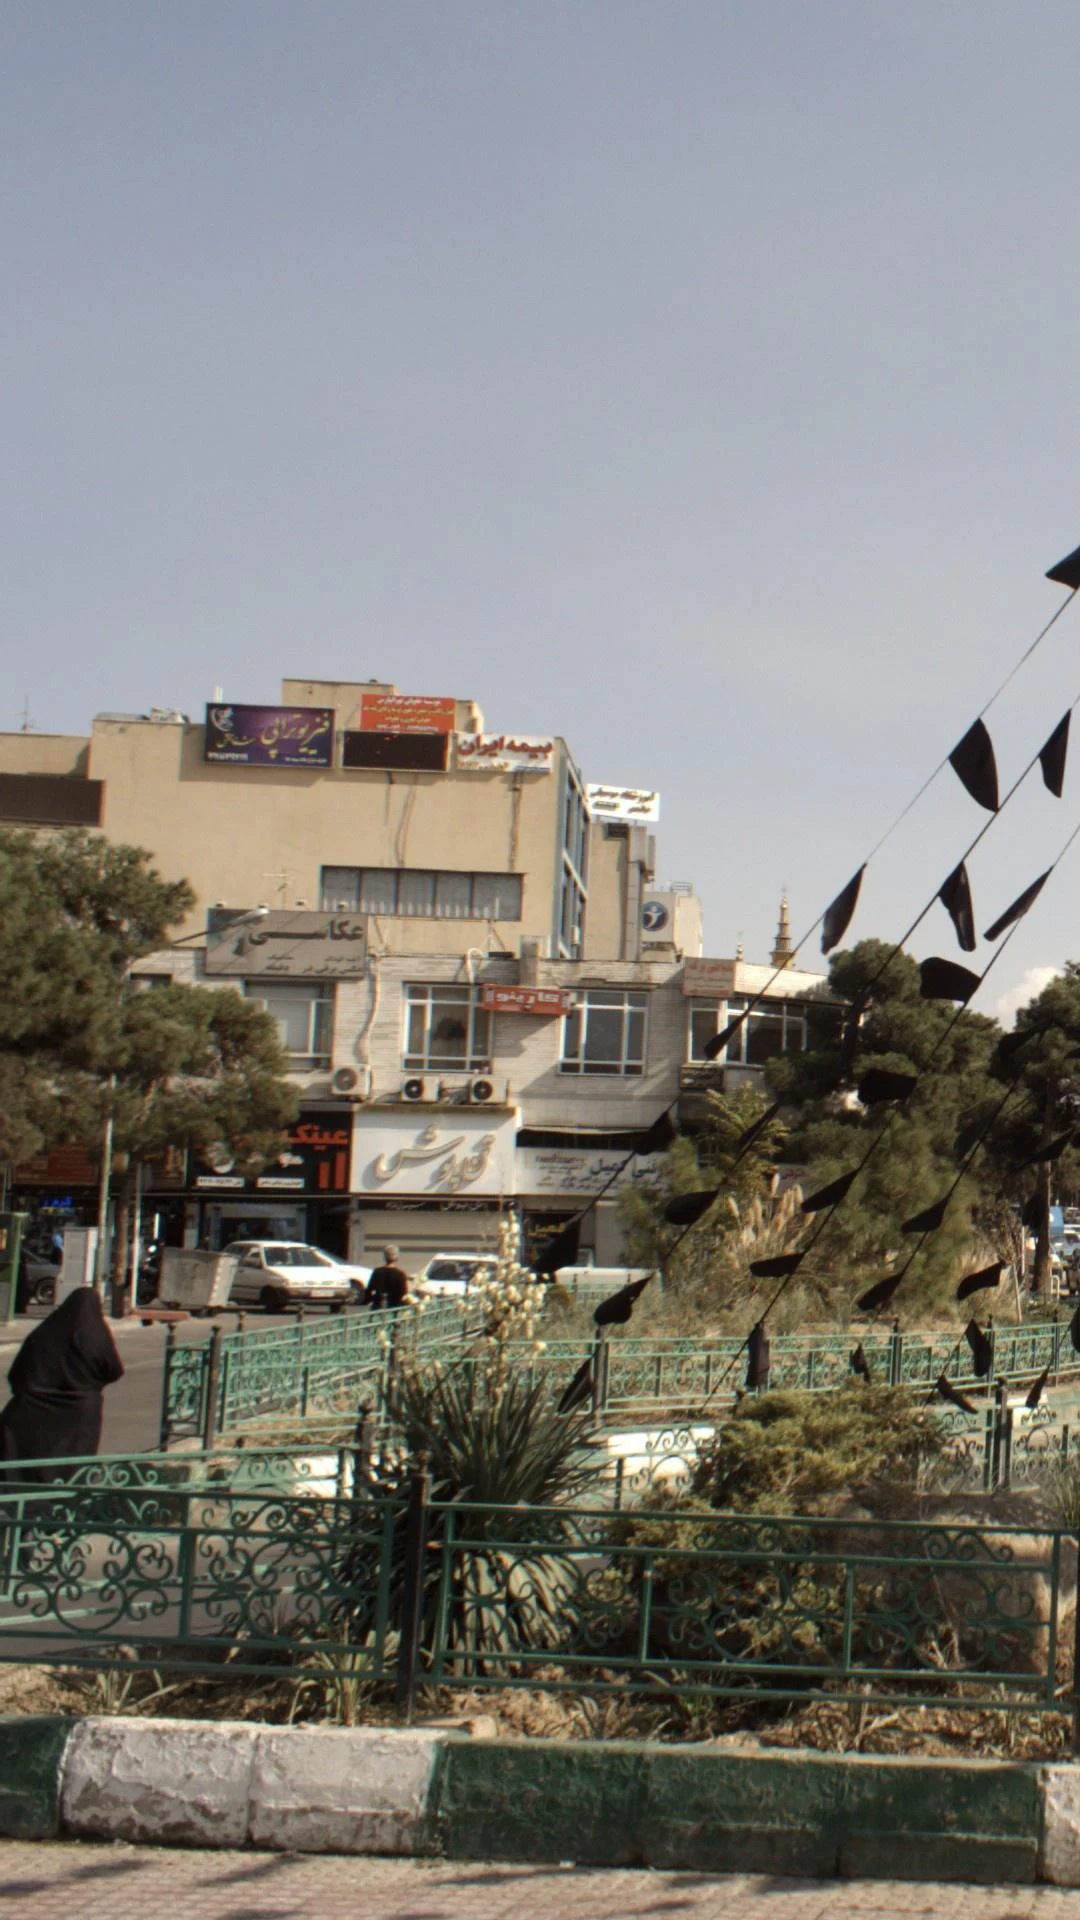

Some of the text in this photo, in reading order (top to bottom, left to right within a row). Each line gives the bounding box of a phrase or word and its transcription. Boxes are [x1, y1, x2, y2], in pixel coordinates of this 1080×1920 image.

[260, 712, 330, 760] فیزیوتراپی
[457, 735, 553, 760] بیمه ایران
[248, 919, 364, 946] عکاسی
